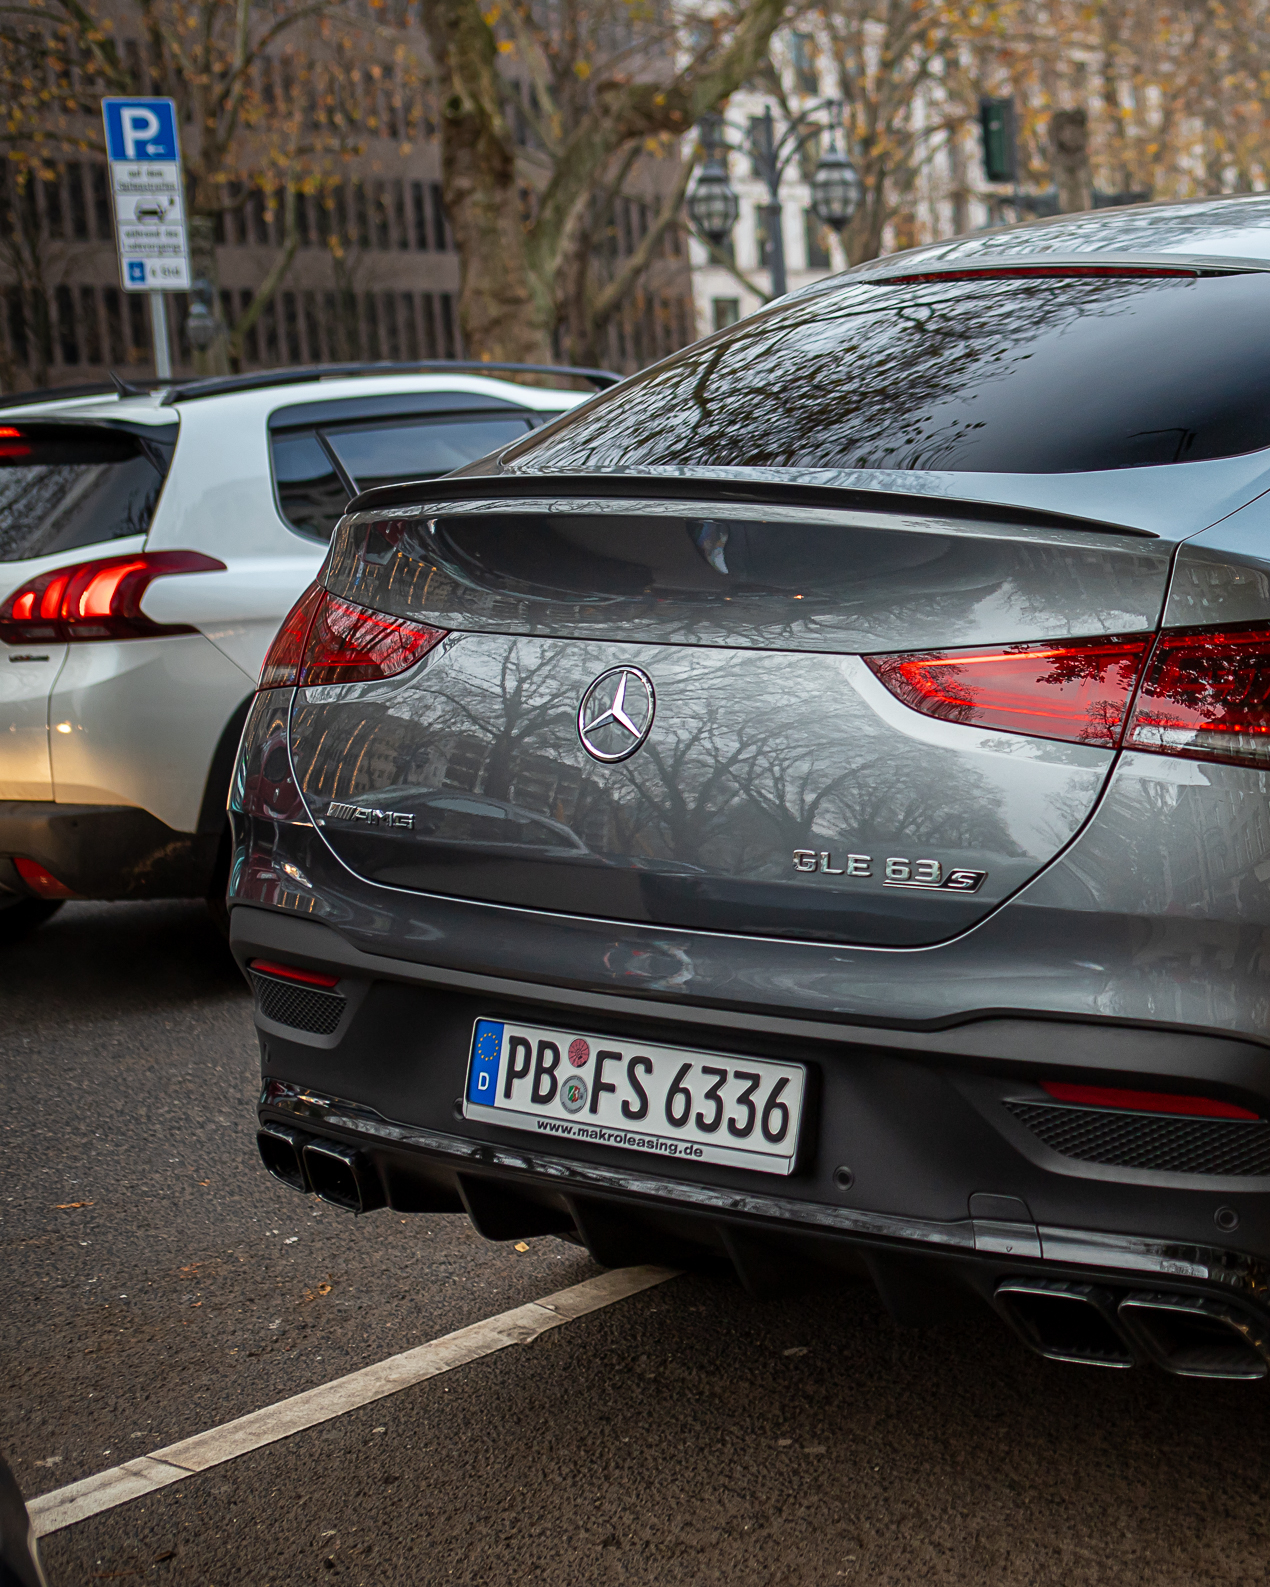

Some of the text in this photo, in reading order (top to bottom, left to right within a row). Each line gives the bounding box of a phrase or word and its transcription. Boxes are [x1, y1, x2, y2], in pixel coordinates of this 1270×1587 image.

[120, 106, 161, 160] P
[351, 806, 416, 830] AMG
[792, 849, 873, 877] GLE
[885, 857, 942, 883] 63
[477, 1071, 490, 1091] D
[503, 1035, 561, 1104] PB
[588, 1049, 654, 1121] FS
[664, 1062, 791, 1144] 6336
[537, 1119, 704, 1158] www.makroleasing.de
